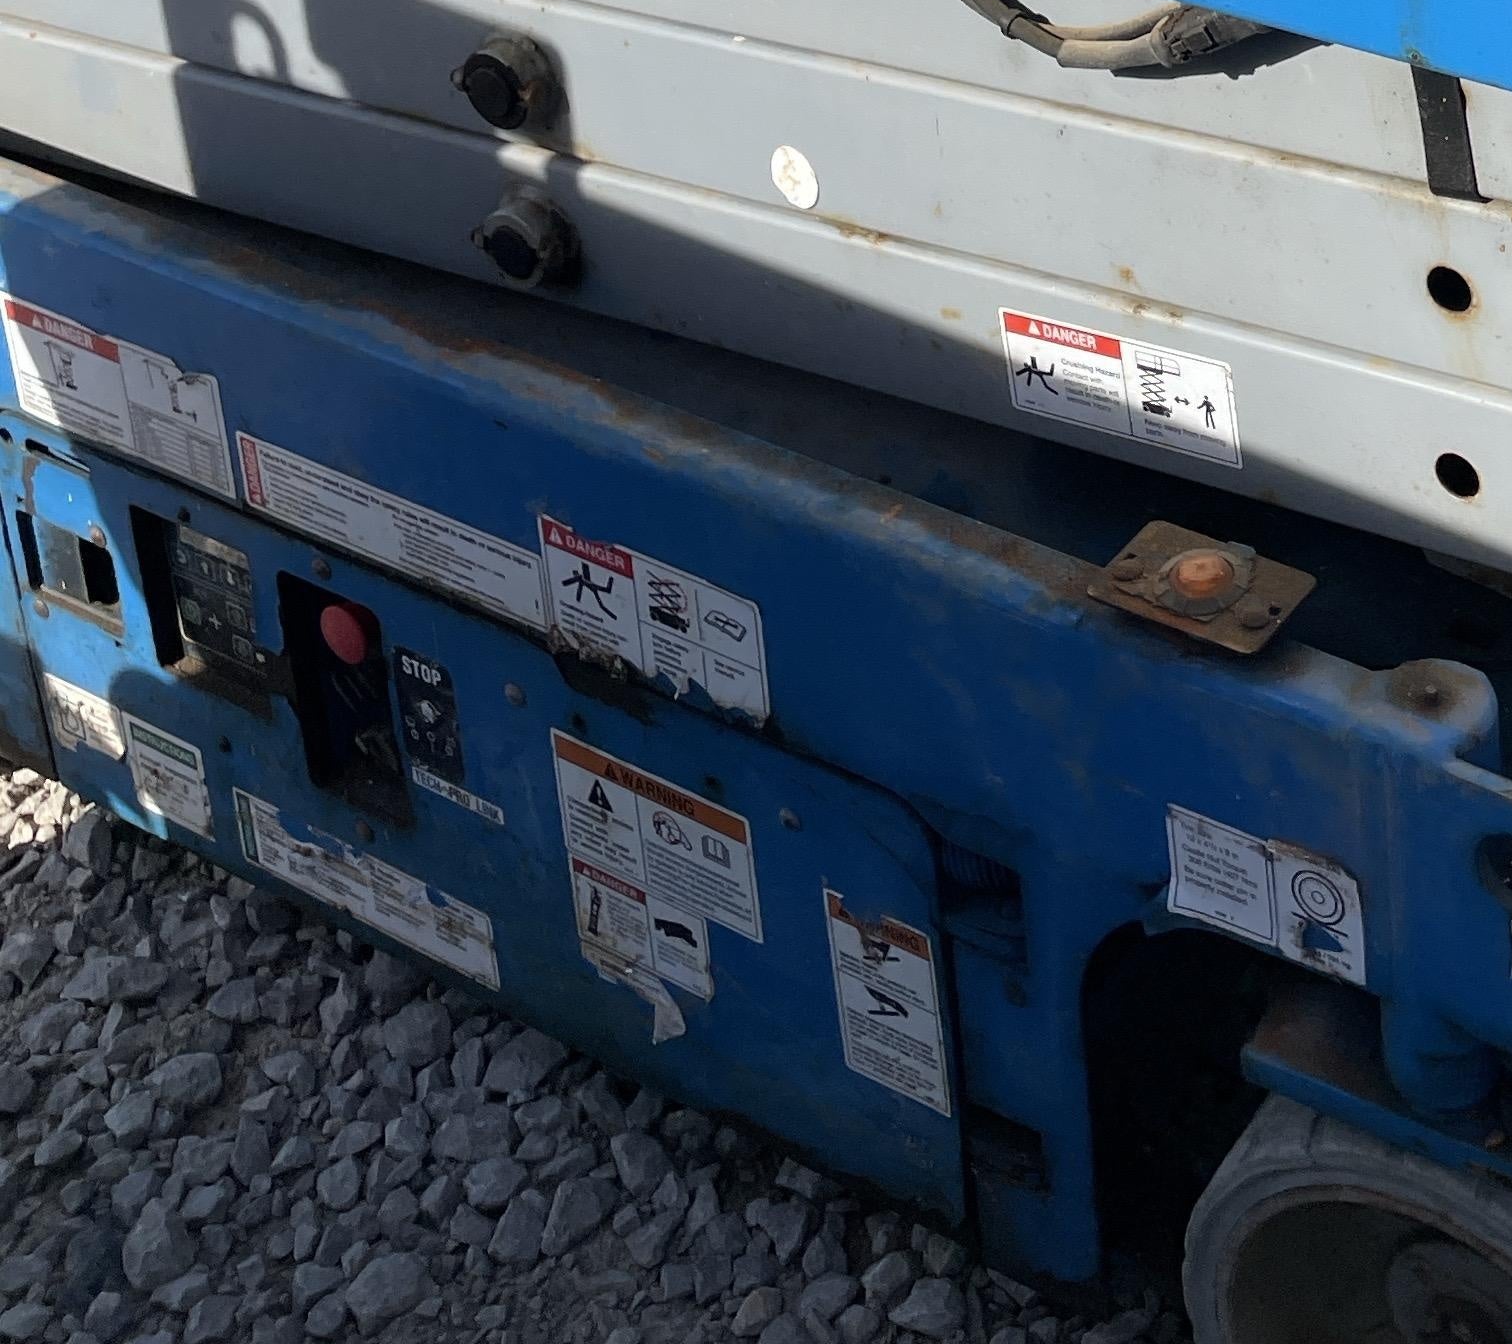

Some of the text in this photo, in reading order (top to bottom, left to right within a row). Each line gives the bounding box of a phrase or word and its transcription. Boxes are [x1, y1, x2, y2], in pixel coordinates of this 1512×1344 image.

[1042, 323, 1097, 351] DANGER
[565, 534, 626, 571] DANGER
[402, 654, 442, 686] STOP
[618, 767, 696, 816] WARNING
[590, 867, 639, 899] DANGER
